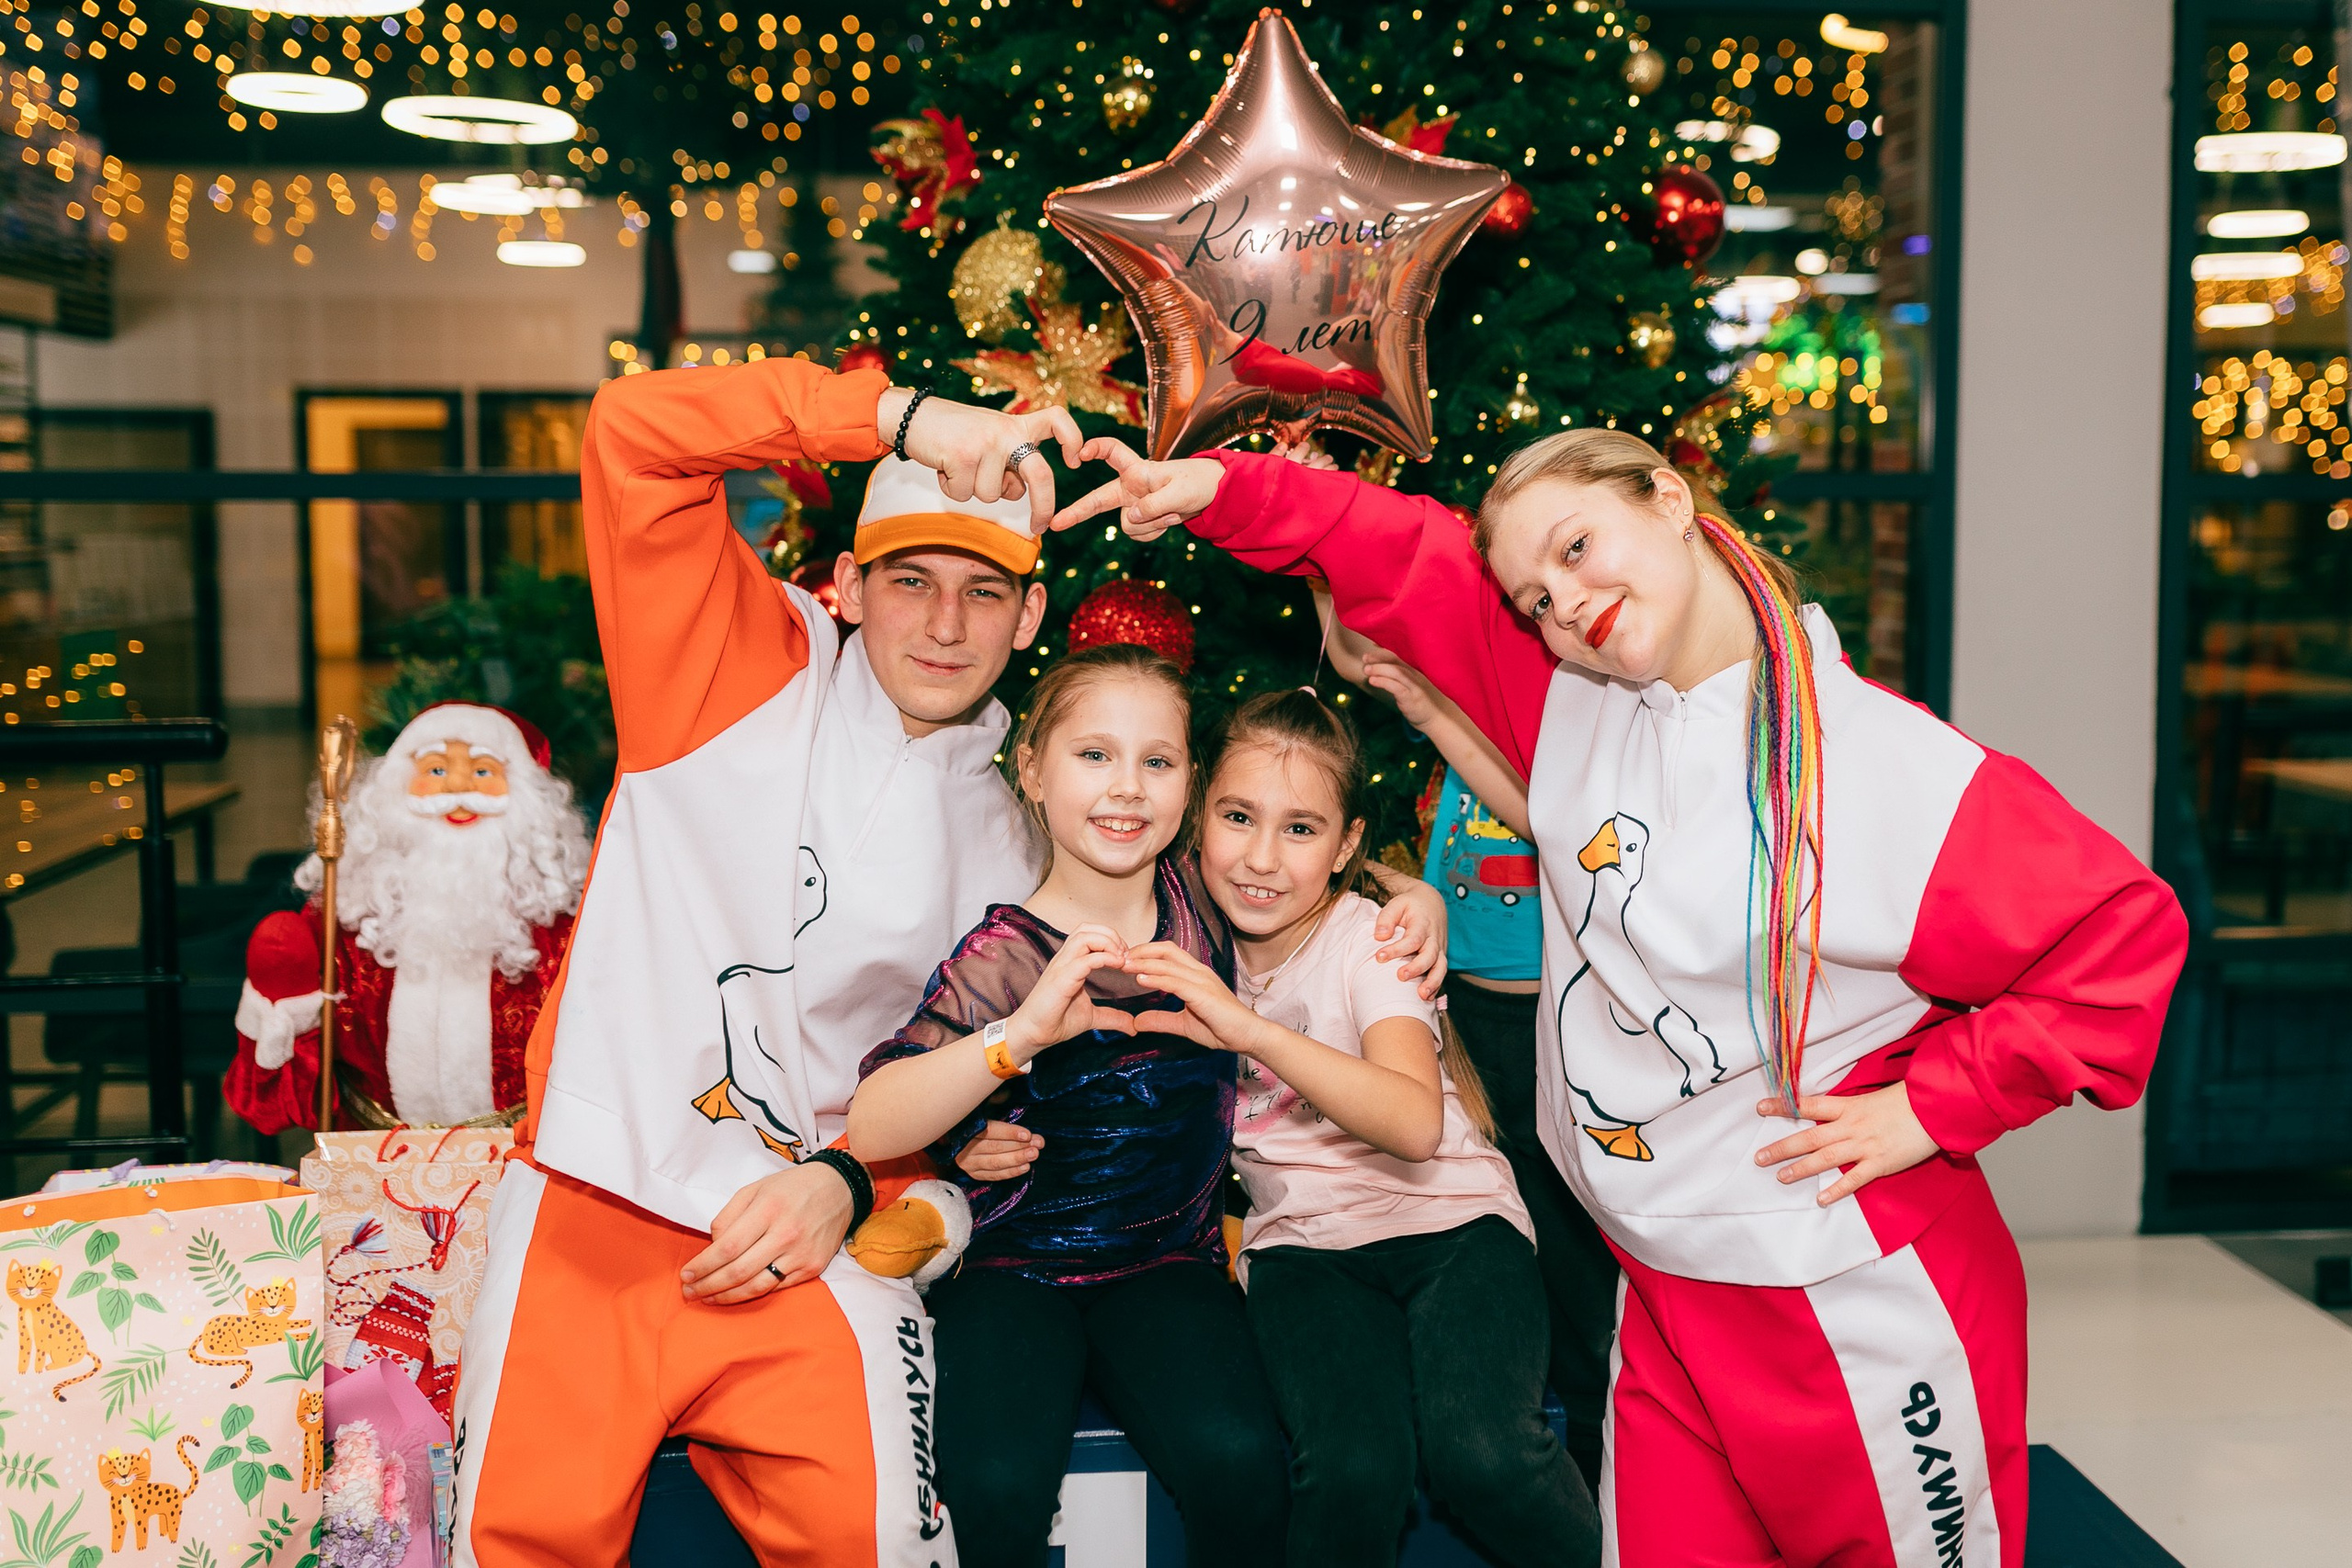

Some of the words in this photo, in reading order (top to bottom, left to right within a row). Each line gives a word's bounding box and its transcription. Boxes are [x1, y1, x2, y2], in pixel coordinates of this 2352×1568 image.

[1177, 195, 1406, 268] Катюше
[1218, 299, 1266, 366] 9
[1281, 319, 1372, 356] лет
